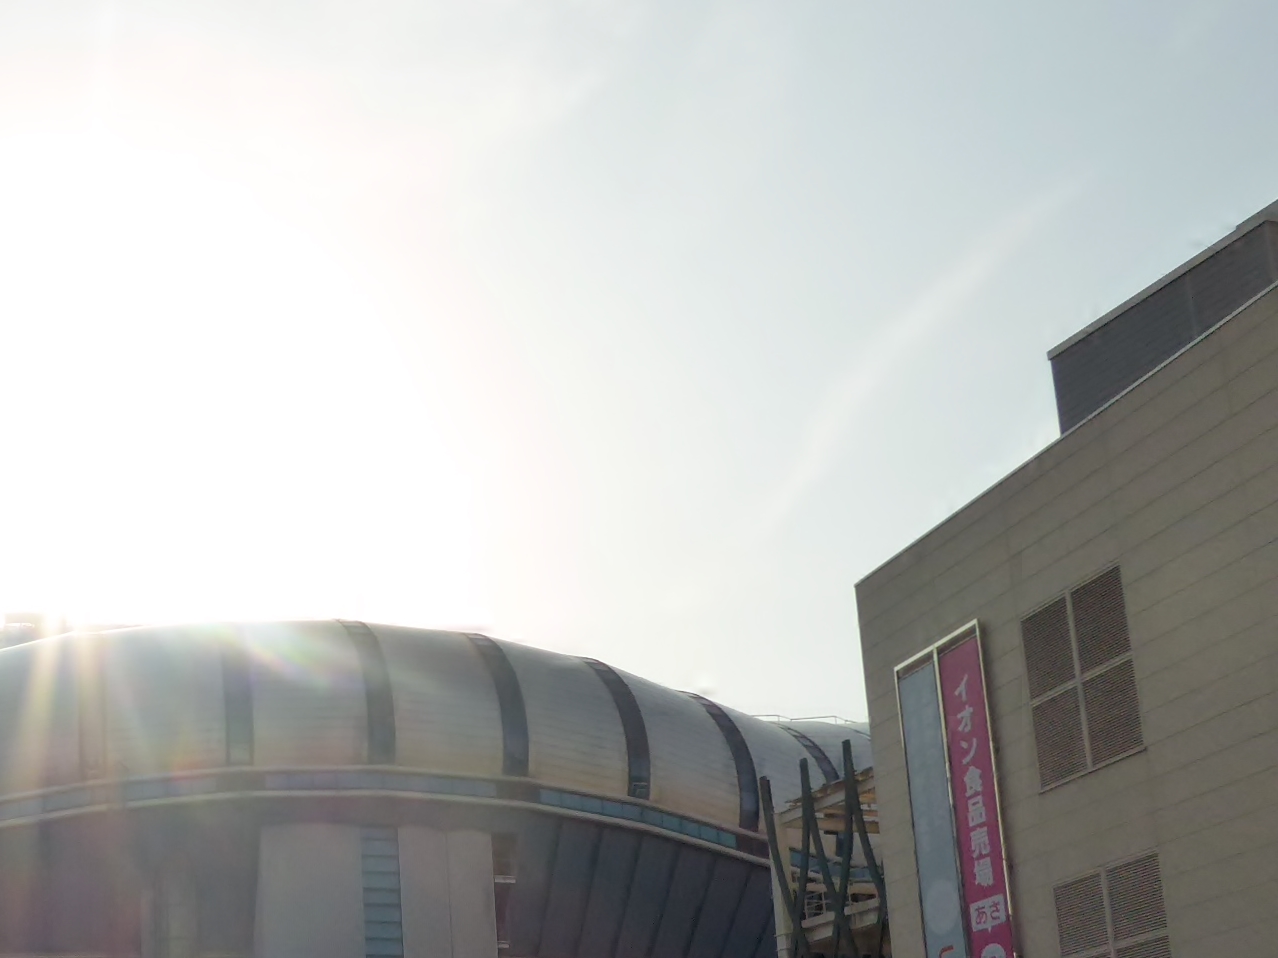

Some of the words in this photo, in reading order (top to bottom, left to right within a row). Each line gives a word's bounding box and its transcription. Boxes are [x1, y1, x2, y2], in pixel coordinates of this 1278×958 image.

[954, 675, 994, 888] イオン食品売場
